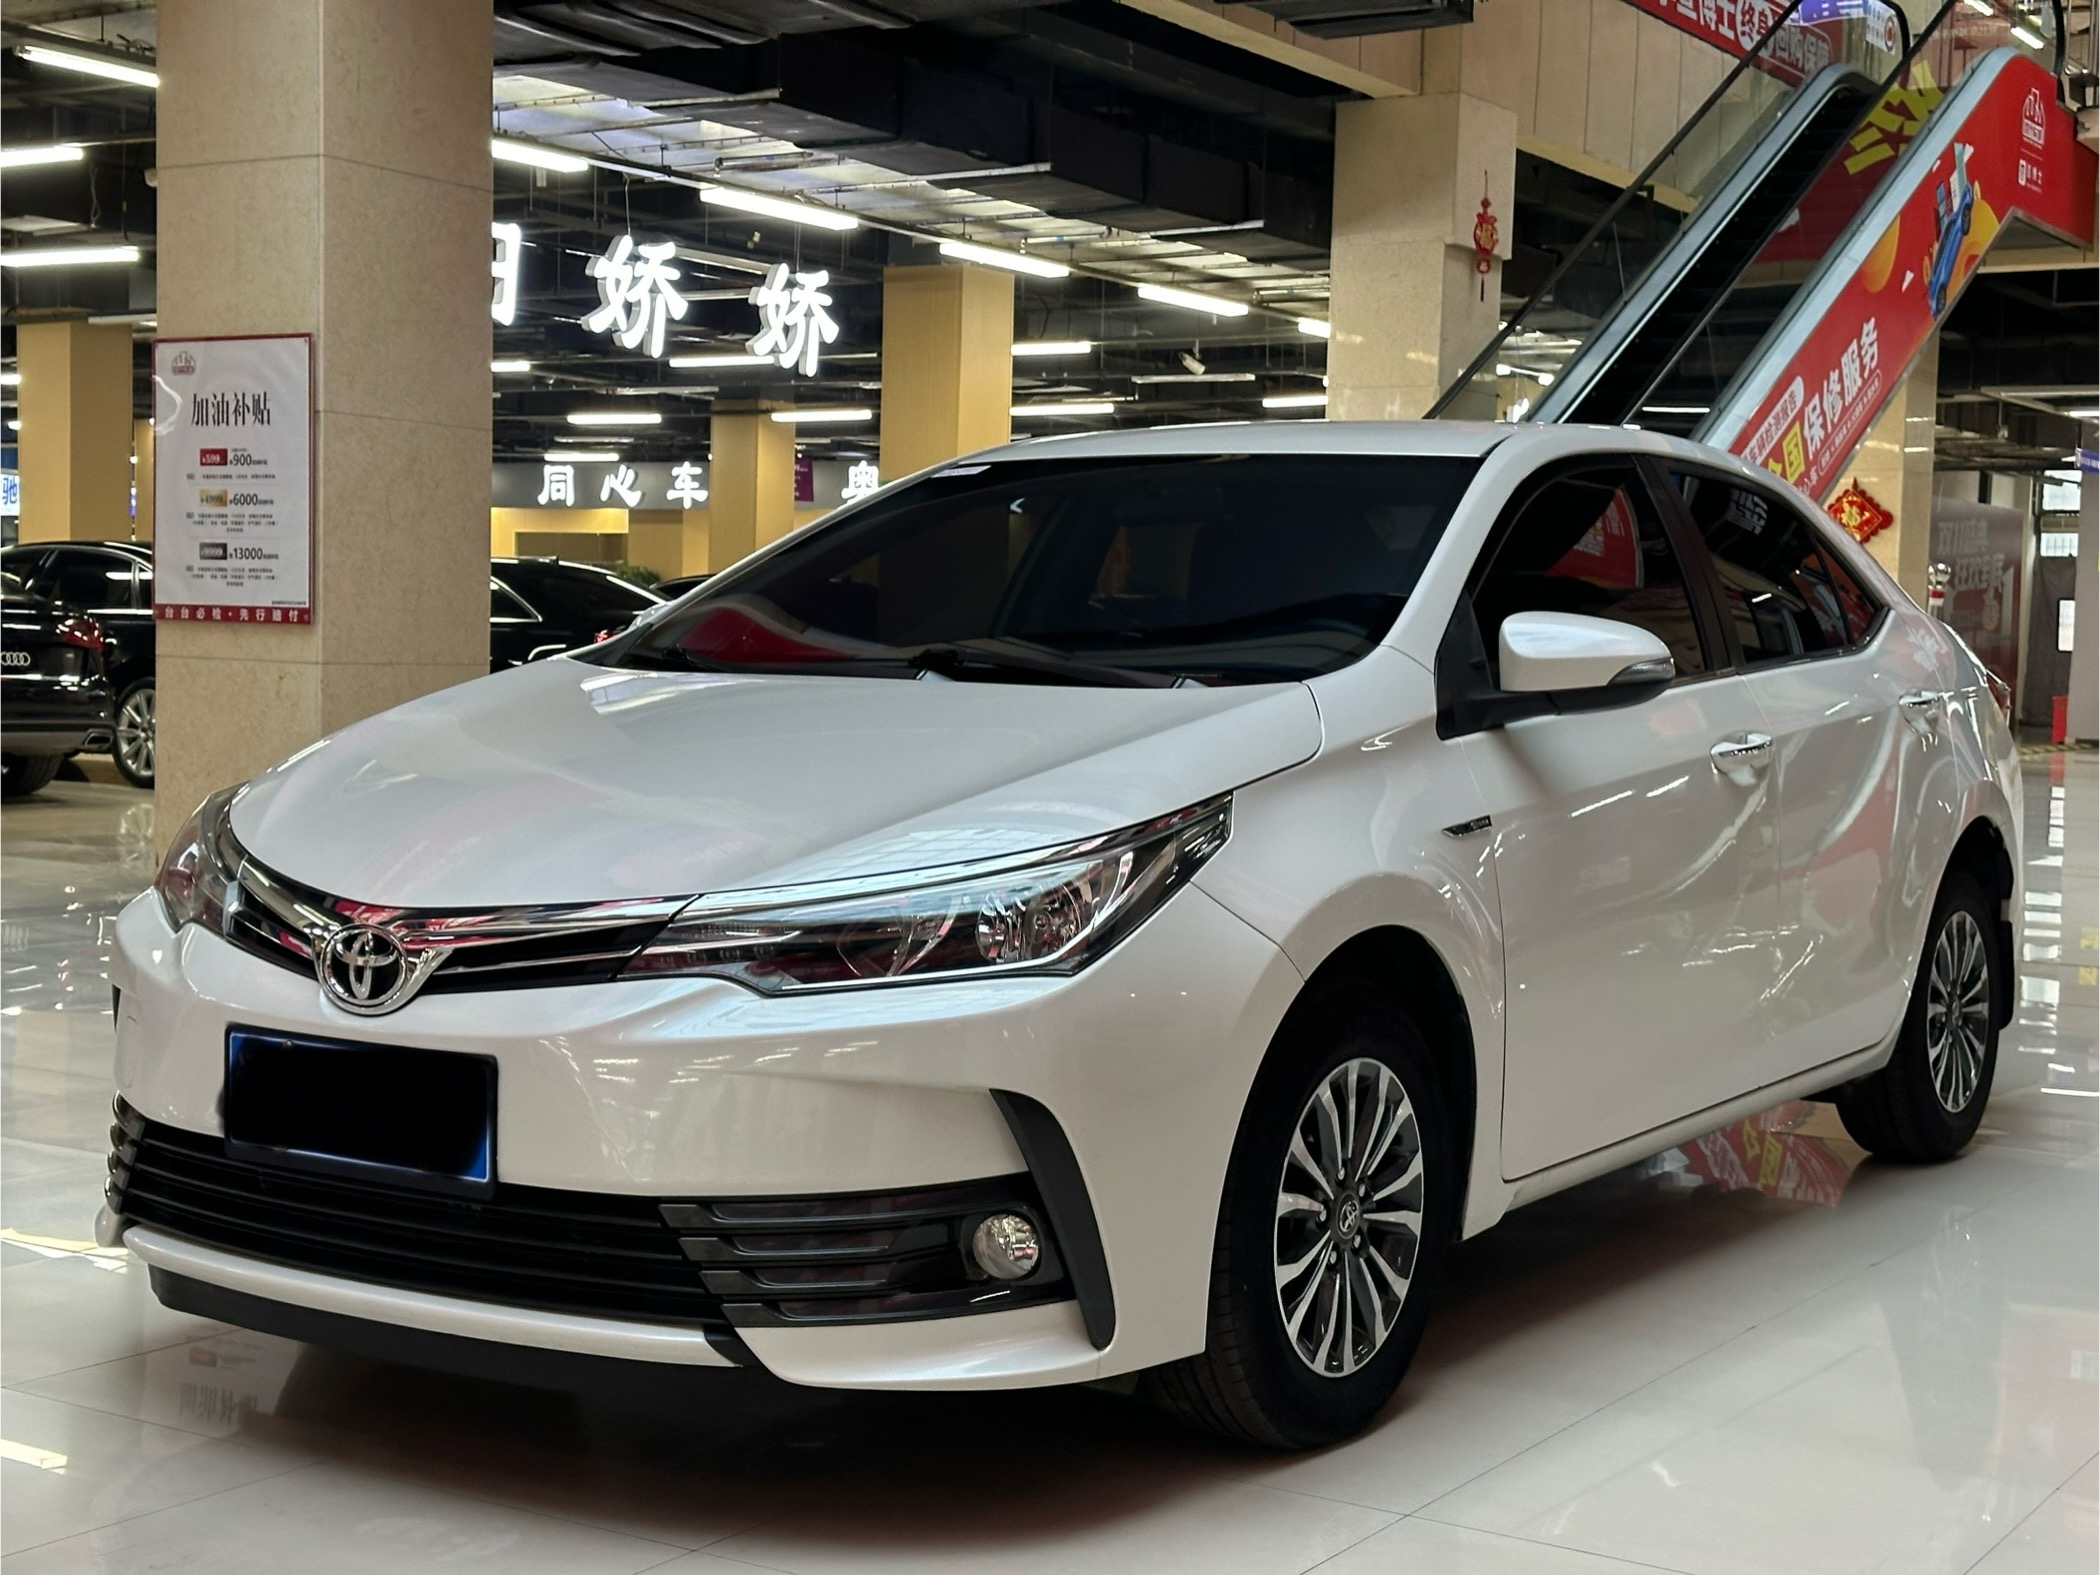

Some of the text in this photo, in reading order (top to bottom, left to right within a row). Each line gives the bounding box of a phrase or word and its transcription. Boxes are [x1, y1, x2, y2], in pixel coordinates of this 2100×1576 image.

[191, 392, 271, 426] 加油补贴
[538, 461, 708, 509] 同心车
